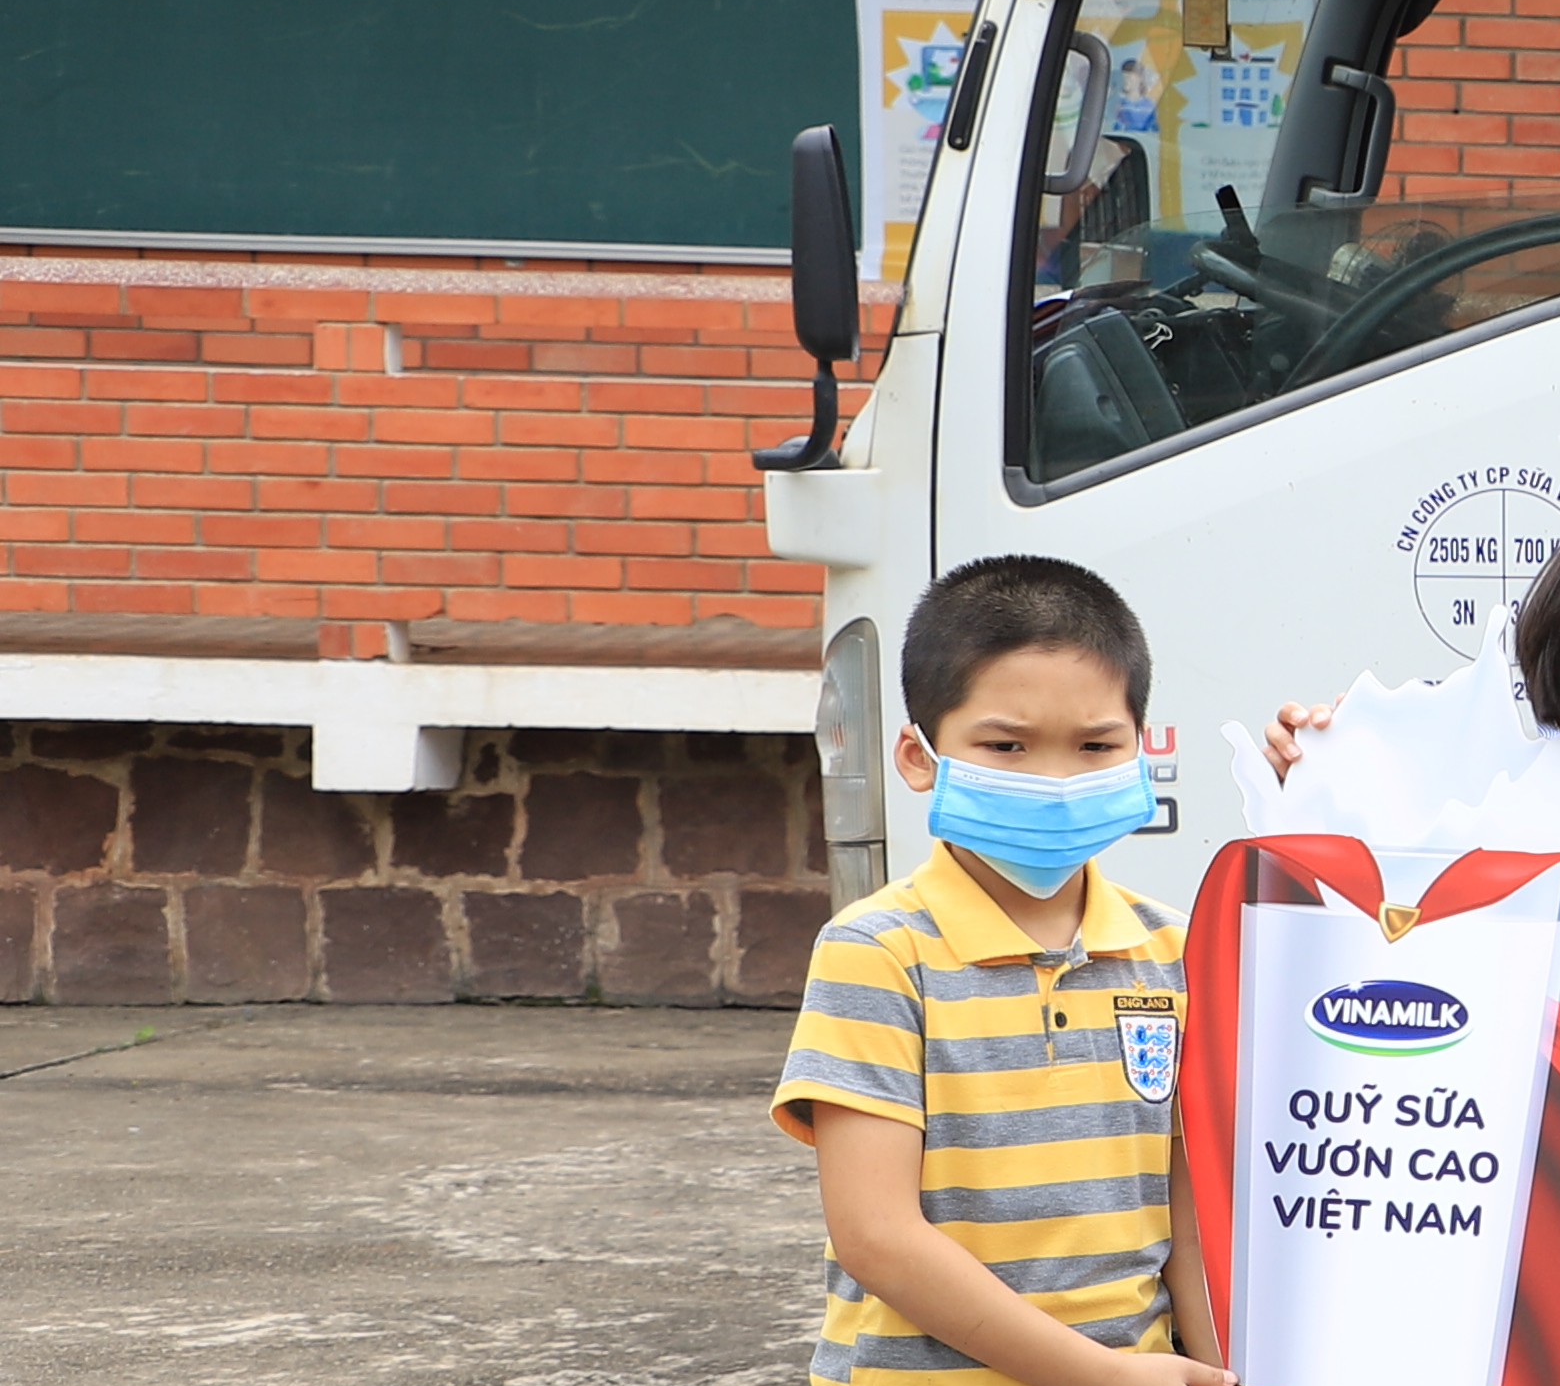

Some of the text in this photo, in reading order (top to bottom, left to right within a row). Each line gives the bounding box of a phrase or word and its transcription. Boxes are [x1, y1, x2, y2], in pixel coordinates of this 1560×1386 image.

[1397, 525, 1419, 552] CN
[1411, 482, 1457, 525] CÔNG
[1457, 470, 1478, 491] TY
[1486, 466, 1510, 485] CP
[1517, 466, 1551, 494] SỮA
[1429, 537, 1498, 563] 2505 KG
[1514, 537, 1544, 563] 700
[1452, 600, 1475, 625] 3N
[1117, 997, 1169, 1009] ENGLAND
[1323, 997, 1461, 1029] VINAMILK
[1289, 1082, 1485, 1131] QUỸ SỮA
[1265, 1137, 1500, 1184] VƯƠN CAO
[1274, 1188, 1483, 1240] VIỆT NAM
